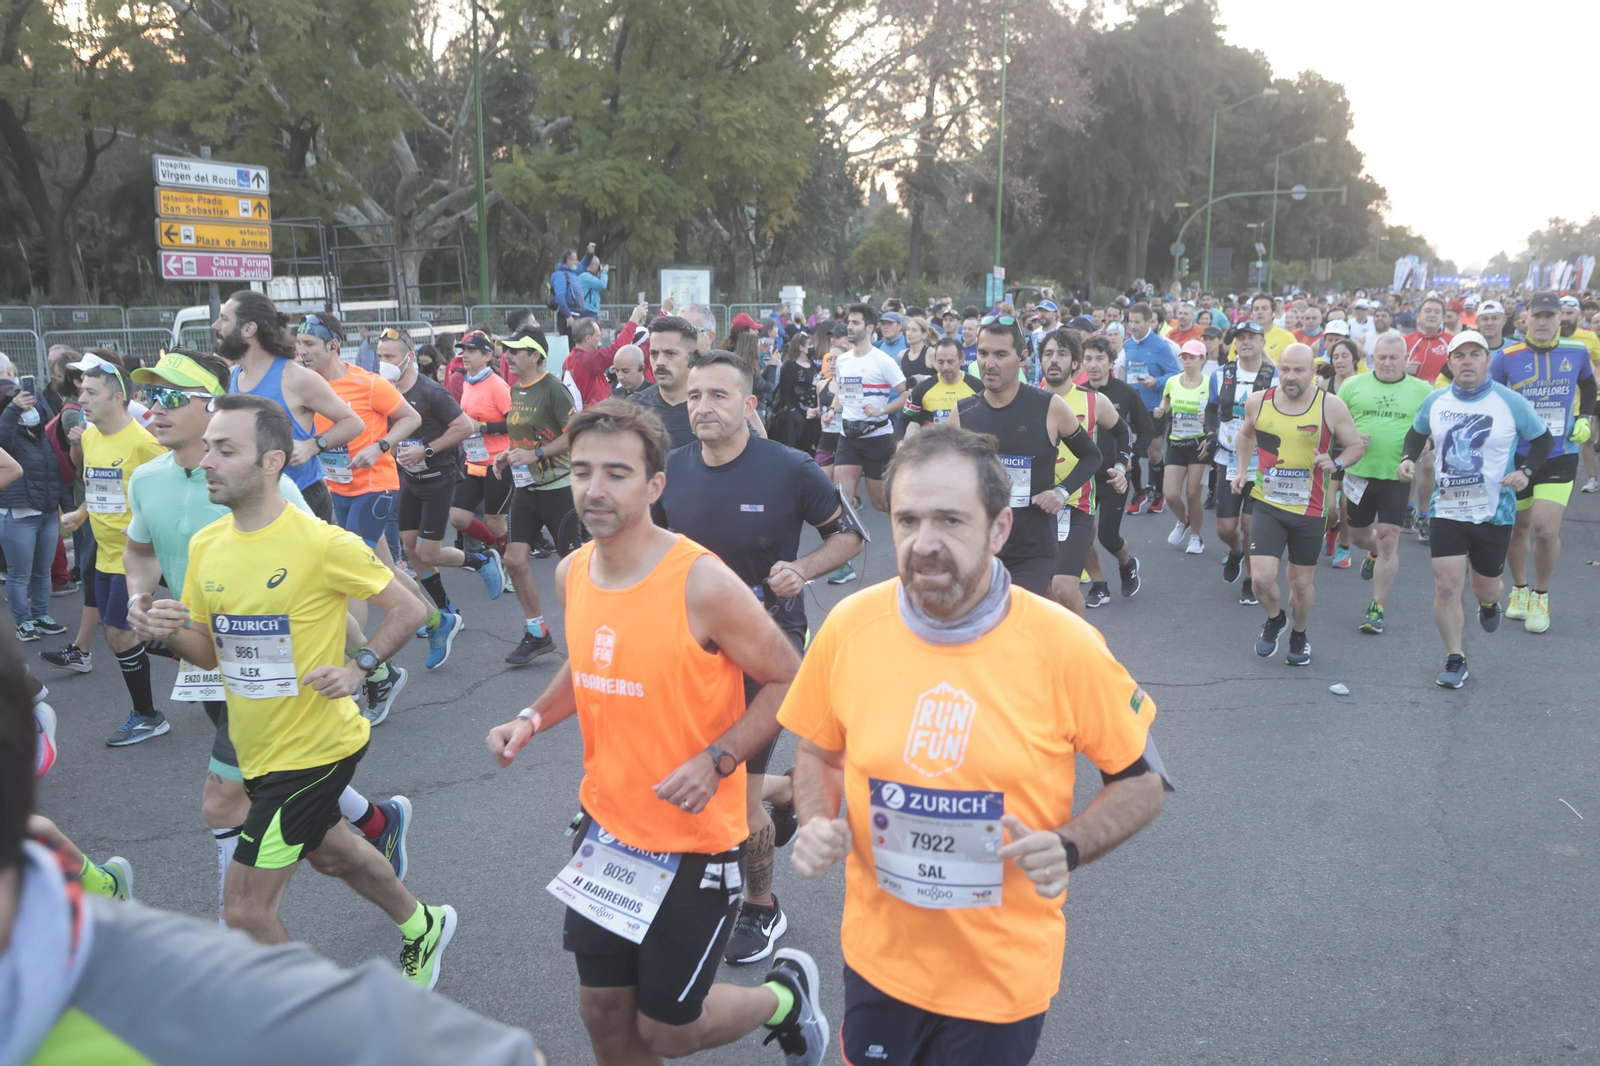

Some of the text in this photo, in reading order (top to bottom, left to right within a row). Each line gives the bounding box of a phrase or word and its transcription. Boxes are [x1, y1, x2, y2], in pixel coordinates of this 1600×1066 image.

[160, 160, 191, 171] hospital
[161, 169, 191, 183] Virgen
[194, 173, 209, 183] del
[197, 195, 222, 205] Prado
[163, 204, 181, 213] San
[196, 236, 268, 248] Plaza de Armas
[212, 256, 269, 267] Caixa Forum
[211, 267, 269, 278] Torre Sevilla
[1522, 386, 1570, 397] MIRAFLORES
[1450, 475, 1479, 486] ZURICH
[231, 620, 279, 631] ZURICH
[235, 646, 259, 659] 9861
[240, 667, 261, 677] ALEX
[184, 674, 201, 683] ENZO
[581, 673, 644, 697] BARREIROS
[918, 699, 971, 732] RUN
[909, 729, 962, 761] FUN
[909, 792, 987, 814] ZURICH
[910, 831, 955, 854] 7922
[602, 862, 637, 885] 8026
[918, 863, 946, 880] SAL
[572, 876, 643, 914] H BARREIROS
